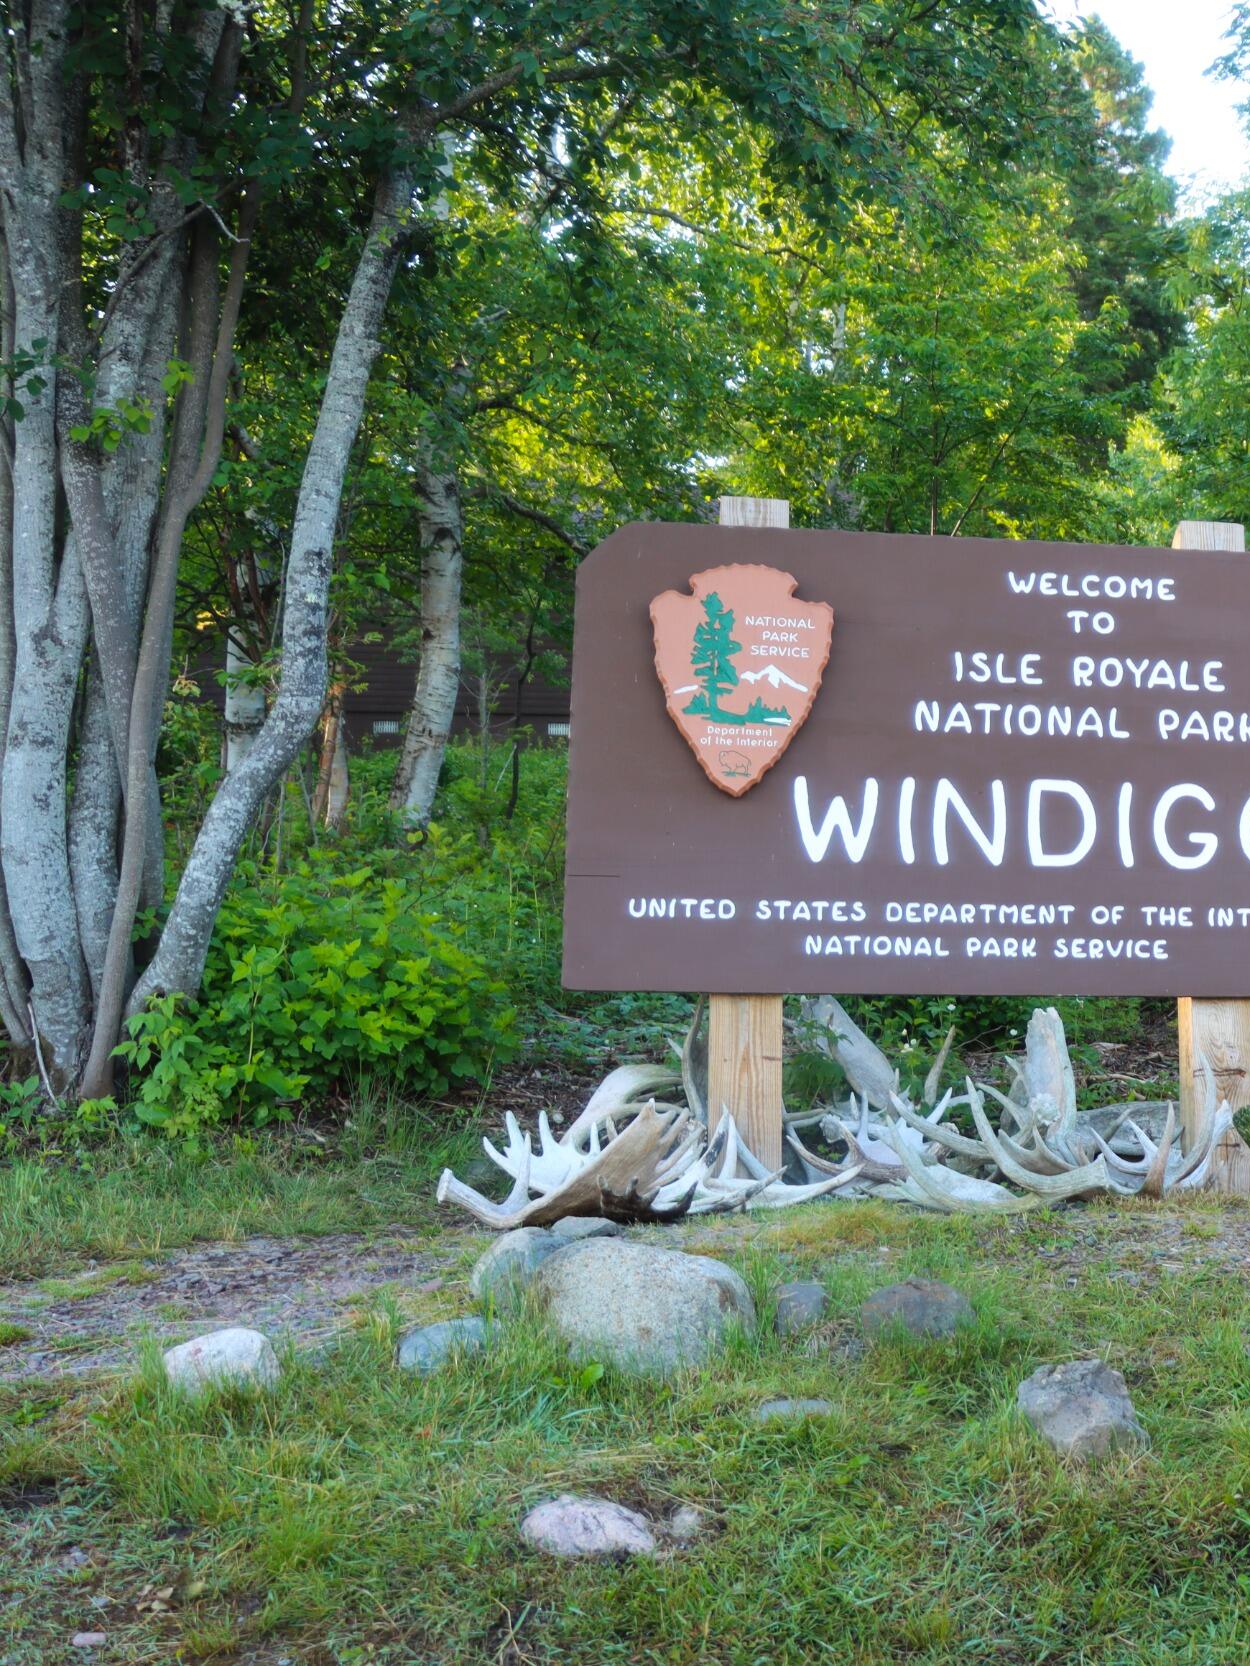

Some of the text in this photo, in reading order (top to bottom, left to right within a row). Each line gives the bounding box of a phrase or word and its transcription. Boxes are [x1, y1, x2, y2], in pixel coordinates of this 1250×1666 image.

[1008, 571, 1176, 601] WELCOME
[745, 615, 816, 629] NATIONAL
[1066, 610, 1115, 635] TO
[762, 630, 798, 643] PARK
[750, 644, 810, 658] SERVICE
[954, 651, 1226, 693] ISLE ROYALE
[707, 725, 773, 737] Department
[914, 700, 1130, 739] NATIONAL
[700, 735, 778, 748] of the Interior
[628, 897, 736, 920] UNITED
[755, 899, 867, 922] STATES
[885, 902, 1076, 925] DEPARTMENT
[1090, 905, 1125, 925] OF
[1140, 906, 1194, 927] THE
[805, 935, 1169, 960] NATIONAL PARK SERVICE
